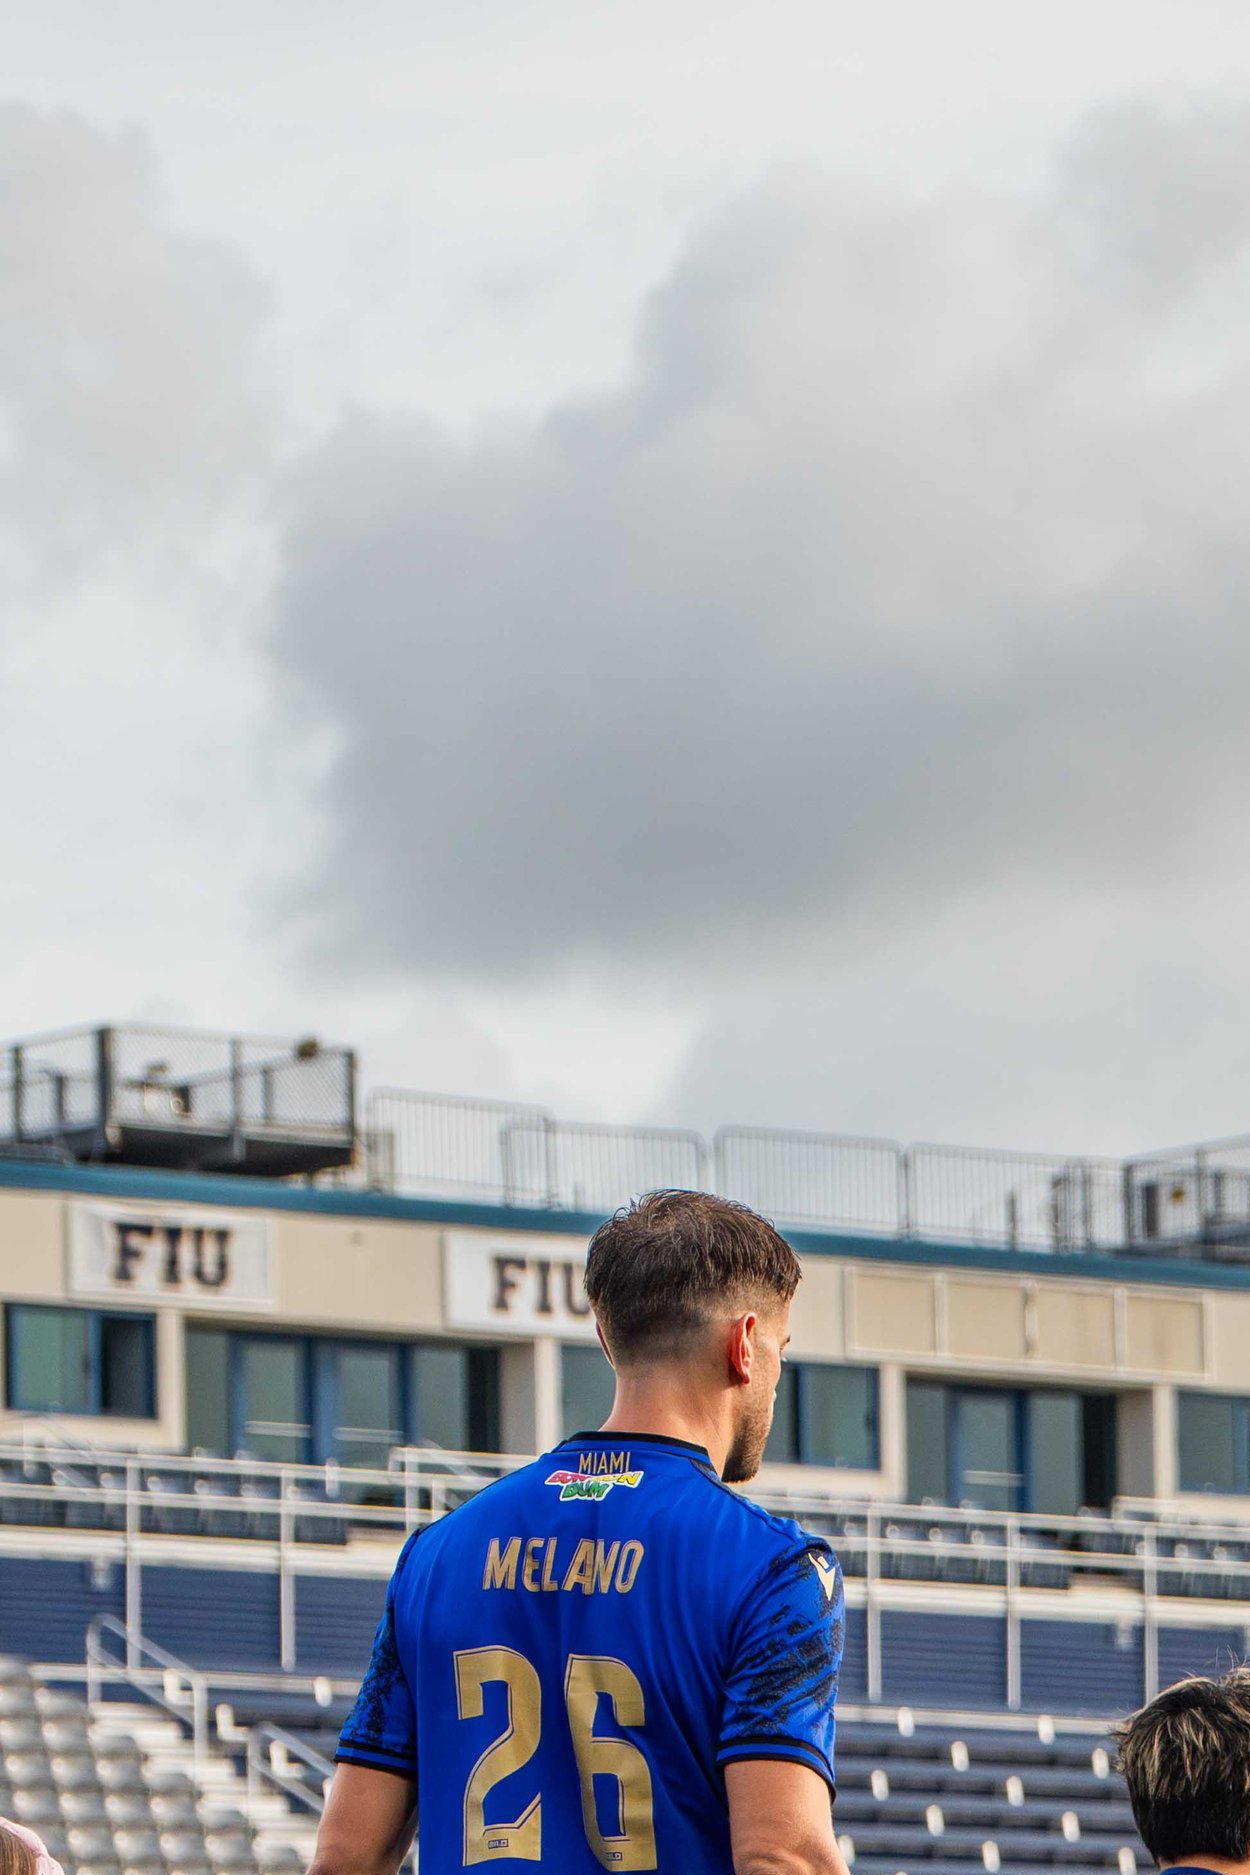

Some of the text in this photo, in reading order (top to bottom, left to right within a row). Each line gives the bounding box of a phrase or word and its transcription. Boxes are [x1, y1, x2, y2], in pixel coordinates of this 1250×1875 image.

[114, 1222, 231, 1287] FIU
[492, 1256, 591, 1315] FIU
[578, 1451, 631, 1474] MIAMI
[482, 1536, 645, 1596] MELANO
[453, 1644, 658, 1873] 26
